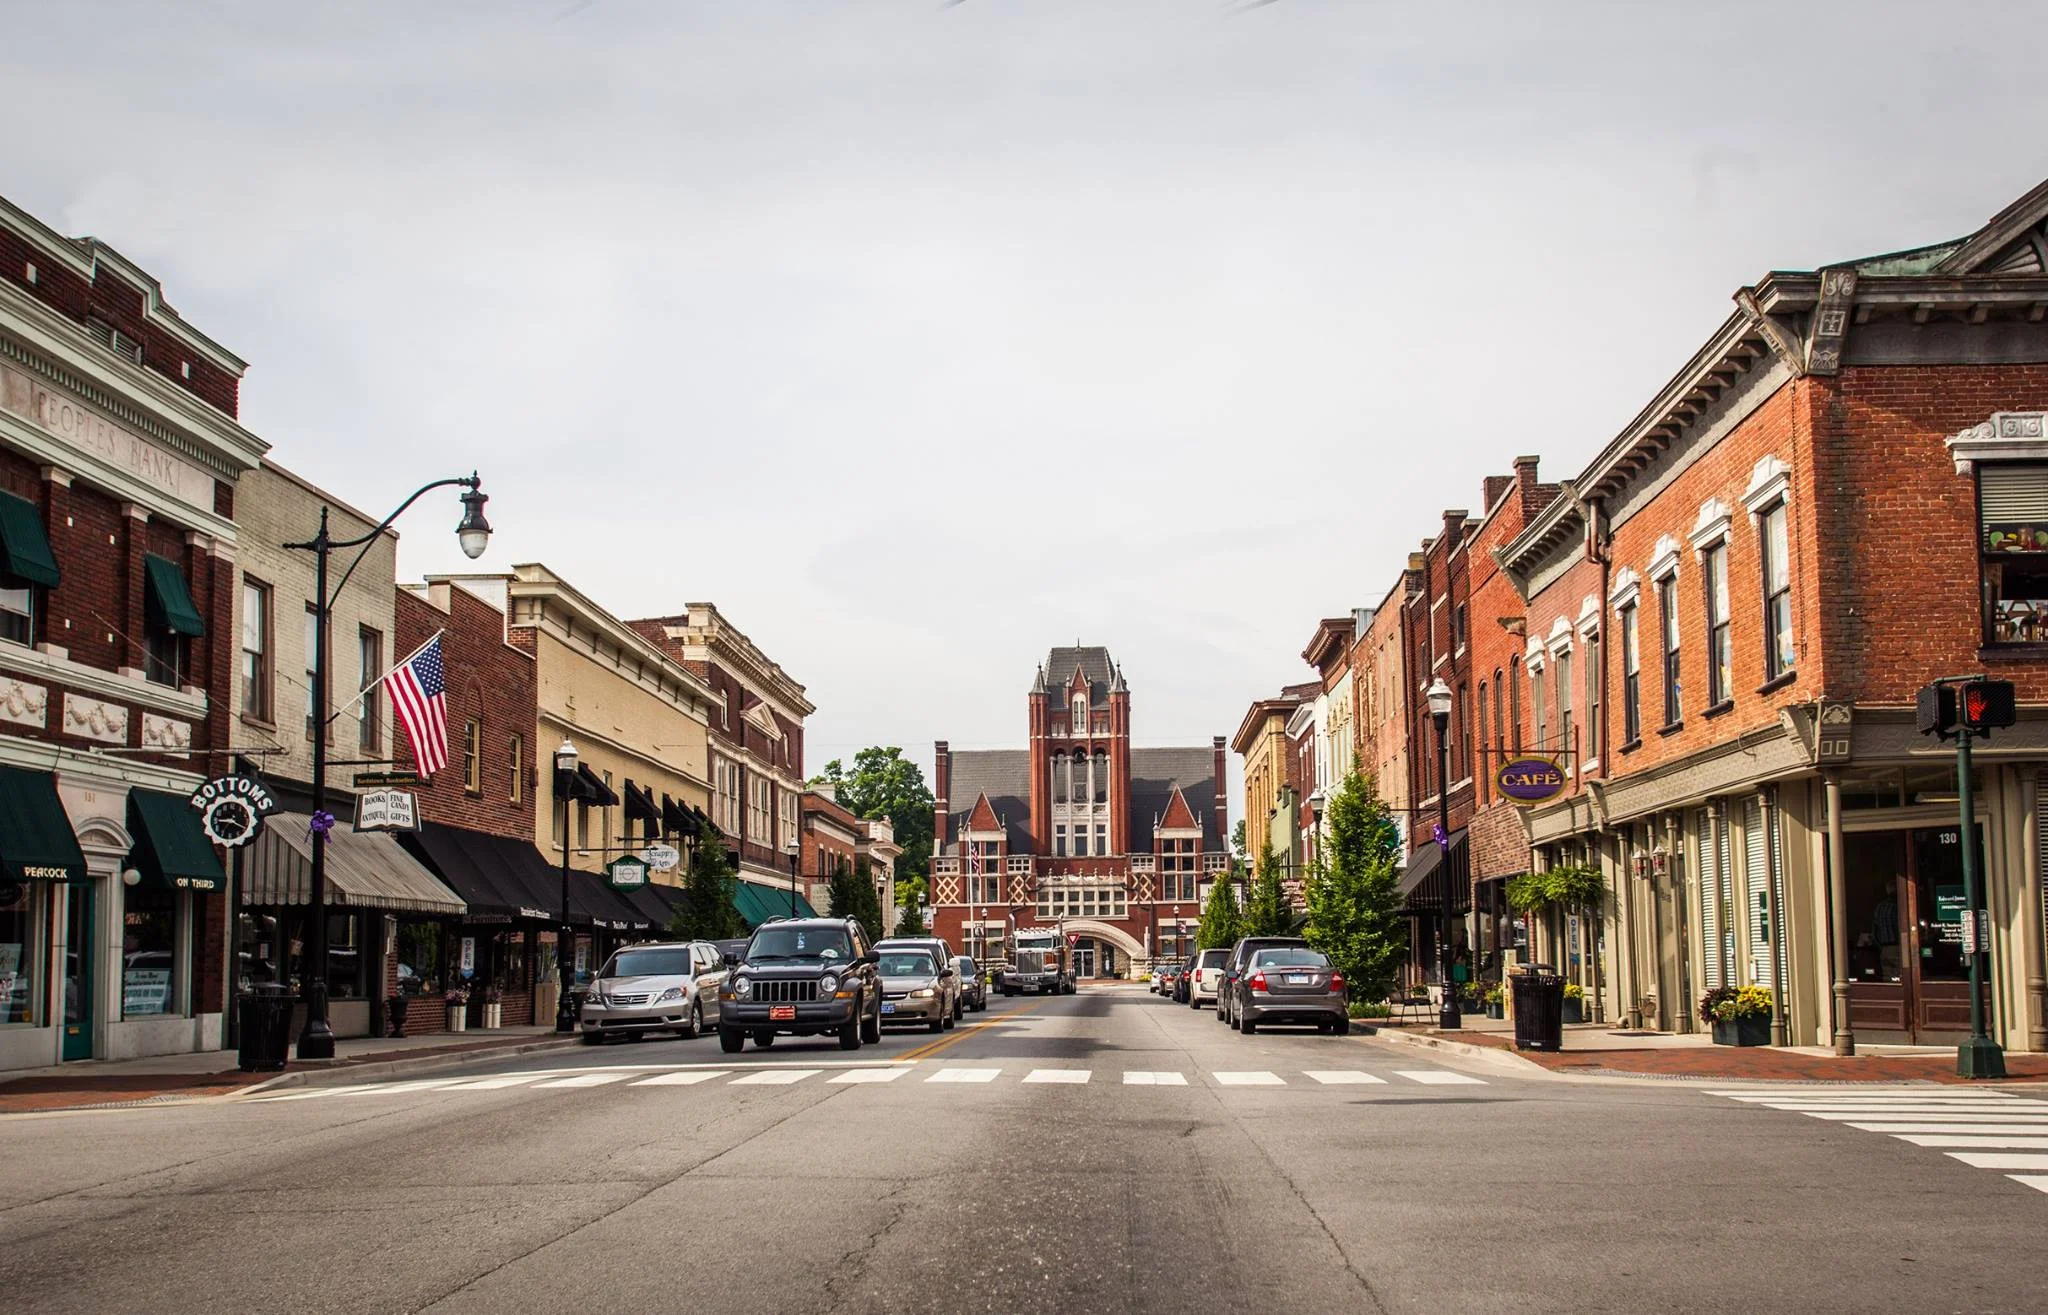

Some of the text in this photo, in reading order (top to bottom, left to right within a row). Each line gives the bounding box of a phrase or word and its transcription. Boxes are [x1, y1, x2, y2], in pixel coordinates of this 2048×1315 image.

[38, 391, 174, 486] PEOPLES BANK
[1501, 769, 1561, 786] CAFÉ
[191, 777, 273, 811] BOTTOMS
[364, 794, 386, 806] BOOKS
[390, 794, 404, 803] FINE
[390, 801, 410, 811] CANDY
[390, 812, 411, 823] GIFTS
[1939, 832, 1958, 844] 130
[24, 866, 68, 879] PEACOCK
[176, 877, 215, 890] ON THIRD
[464, 938, 472, 968] OPEN
